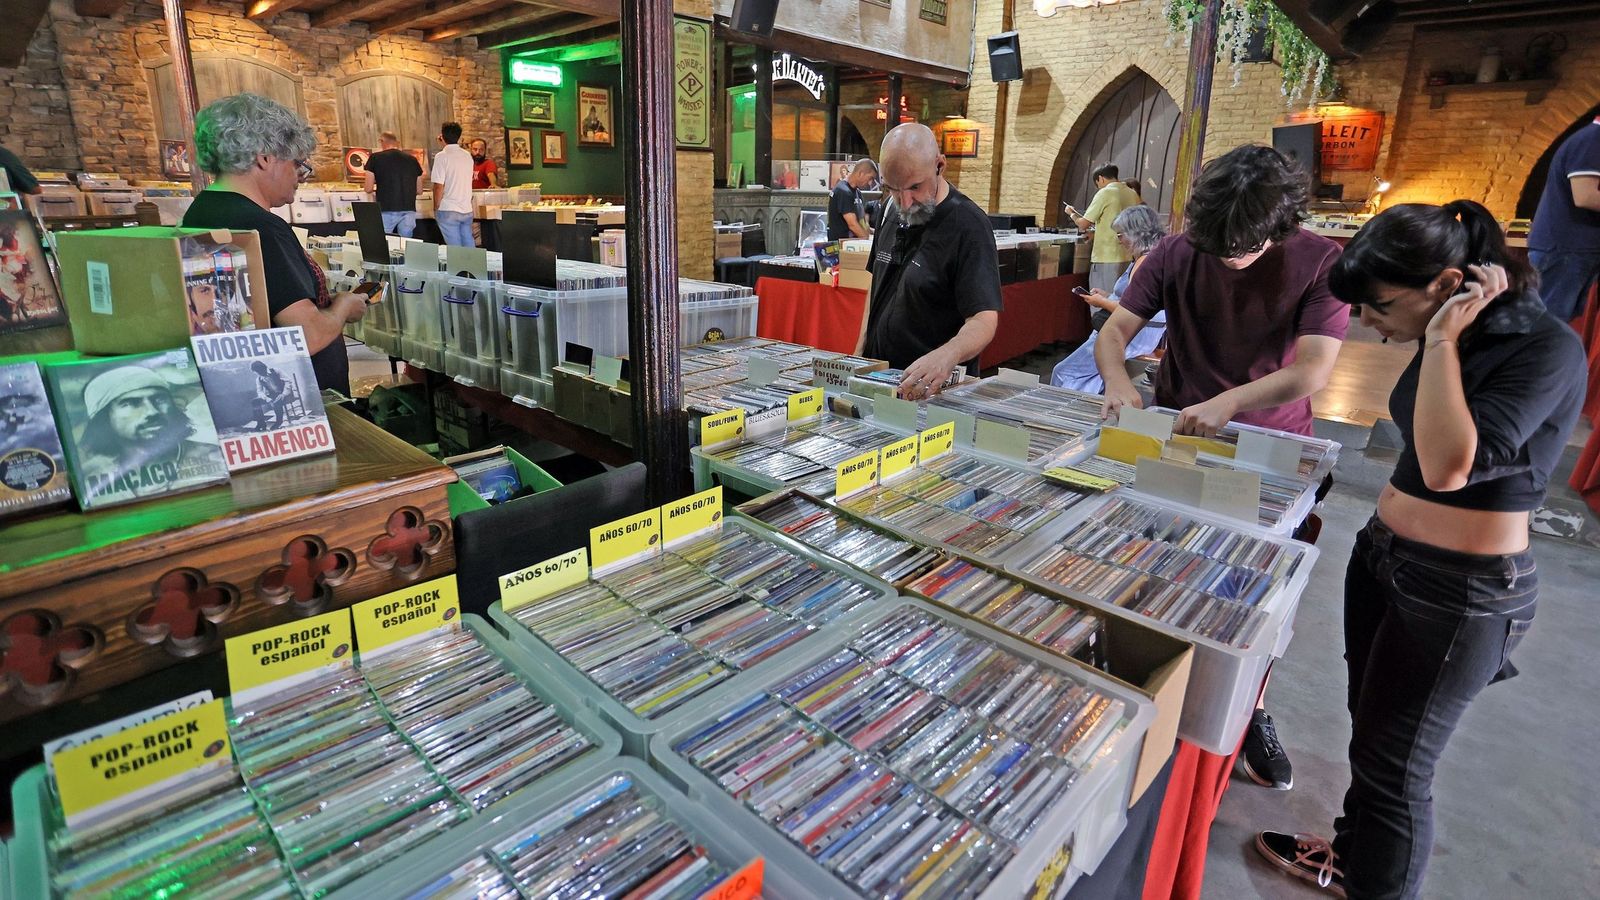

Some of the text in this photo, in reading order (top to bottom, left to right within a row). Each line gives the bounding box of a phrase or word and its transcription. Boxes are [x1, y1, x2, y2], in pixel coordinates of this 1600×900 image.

[676, 58, 705, 74] POWER'S
[687, 78, 696, 92] P
[677, 95, 705, 112] WHISKEY
[1322, 141, 1356, 149] RBON
[197, 329, 304, 363] MORENTE
[814, 359, 853, 373] COLECCION
[826, 377, 849, 387] ESPEC
[798, 395, 814, 405] BLUES
[707, 414, 739, 429] SOUL/FUNK
[223, 424, 330, 466] FLAMENCO
[924, 428, 950, 443] AÑOS 60/70
[885, 442, 914, 459] AÑOS 60/70
[842, 457, 873, 476] AÑOS 60/70
[88, 461, 178, 498] MACACO
[669, 495, 716, 519] AÑOS 60/70
[599, 517, 652, 543] AÑOS 60/70
[504, 566, 542, 589] AÑOS
[374, 588, 441, 619] POP-ROCK
[382, 602, 437, 629] español
[252, 624, 331, 655] POP-ROCK
[260, 638, 326, 667] español
[90, 719, 200, 769] POP-ROCK
[104, 737, 193, 780] español
